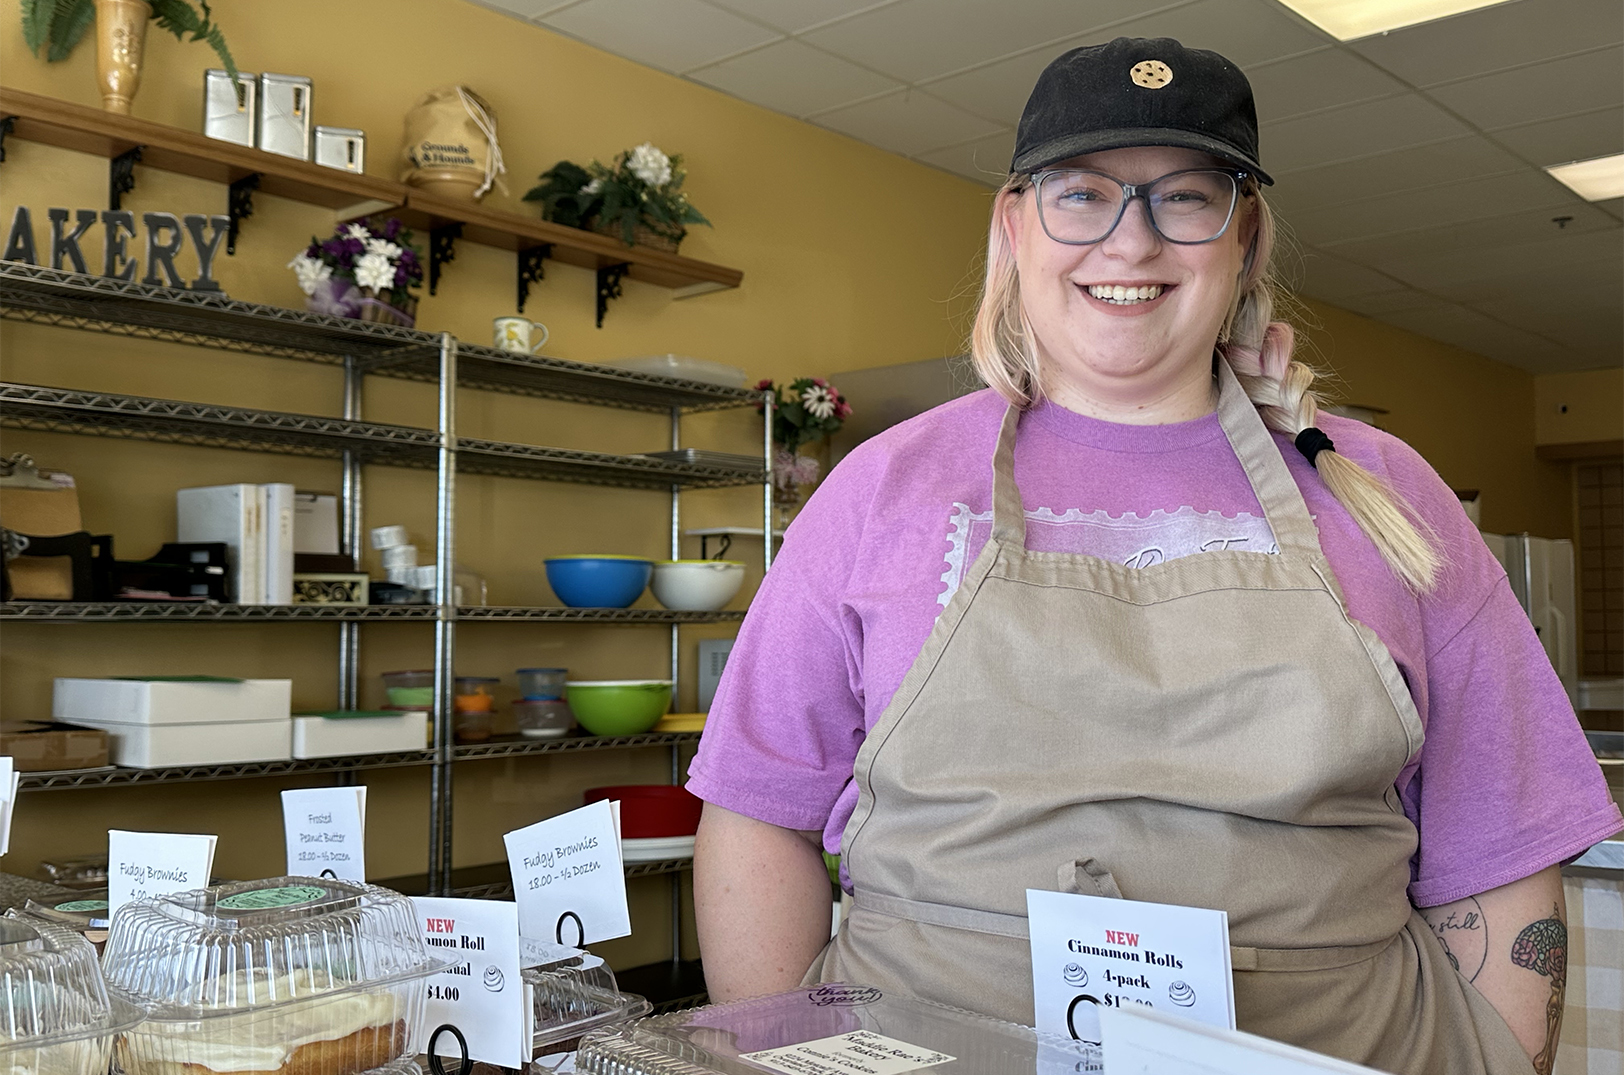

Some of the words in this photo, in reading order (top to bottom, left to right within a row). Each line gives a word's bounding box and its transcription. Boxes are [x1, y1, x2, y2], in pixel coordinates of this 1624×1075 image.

[421, 141, 469, 154] Grounds
[423, 152, 432, 162] &
[433, 153, 475, 165] Hounds
[308, 812, 332, 824] Frosted
[299, 833, 323, 843] Peanut
[323, 832, 345, 843] Butter
[330, 852, 350, 861] Dozen
[523, 850, 555, 870] Fudgy
[554, 836, 599, 859] Brownies
[120, 862, 145, 885] Fudgy
[146, 866, 188, 883] Brownies
[528, 873, 552, 891] 18.00
[573, 860, 601, 877] Dozen
[426, 918, 456, 934] NEW
[1439, 912, 1480, 933] still
[460, 934, 486, 951] Roll
[1105, 929, 1140, 947] NEW
[1067, 938, 1141, 963] Cinnamon
[1143, 950, 1184, 970] Rolls
[1102, 968, 1152, 990] 4-pack
[845, 1045, 891, 1061] Bakery
[838, 1059, 878, 1075] Cookies
